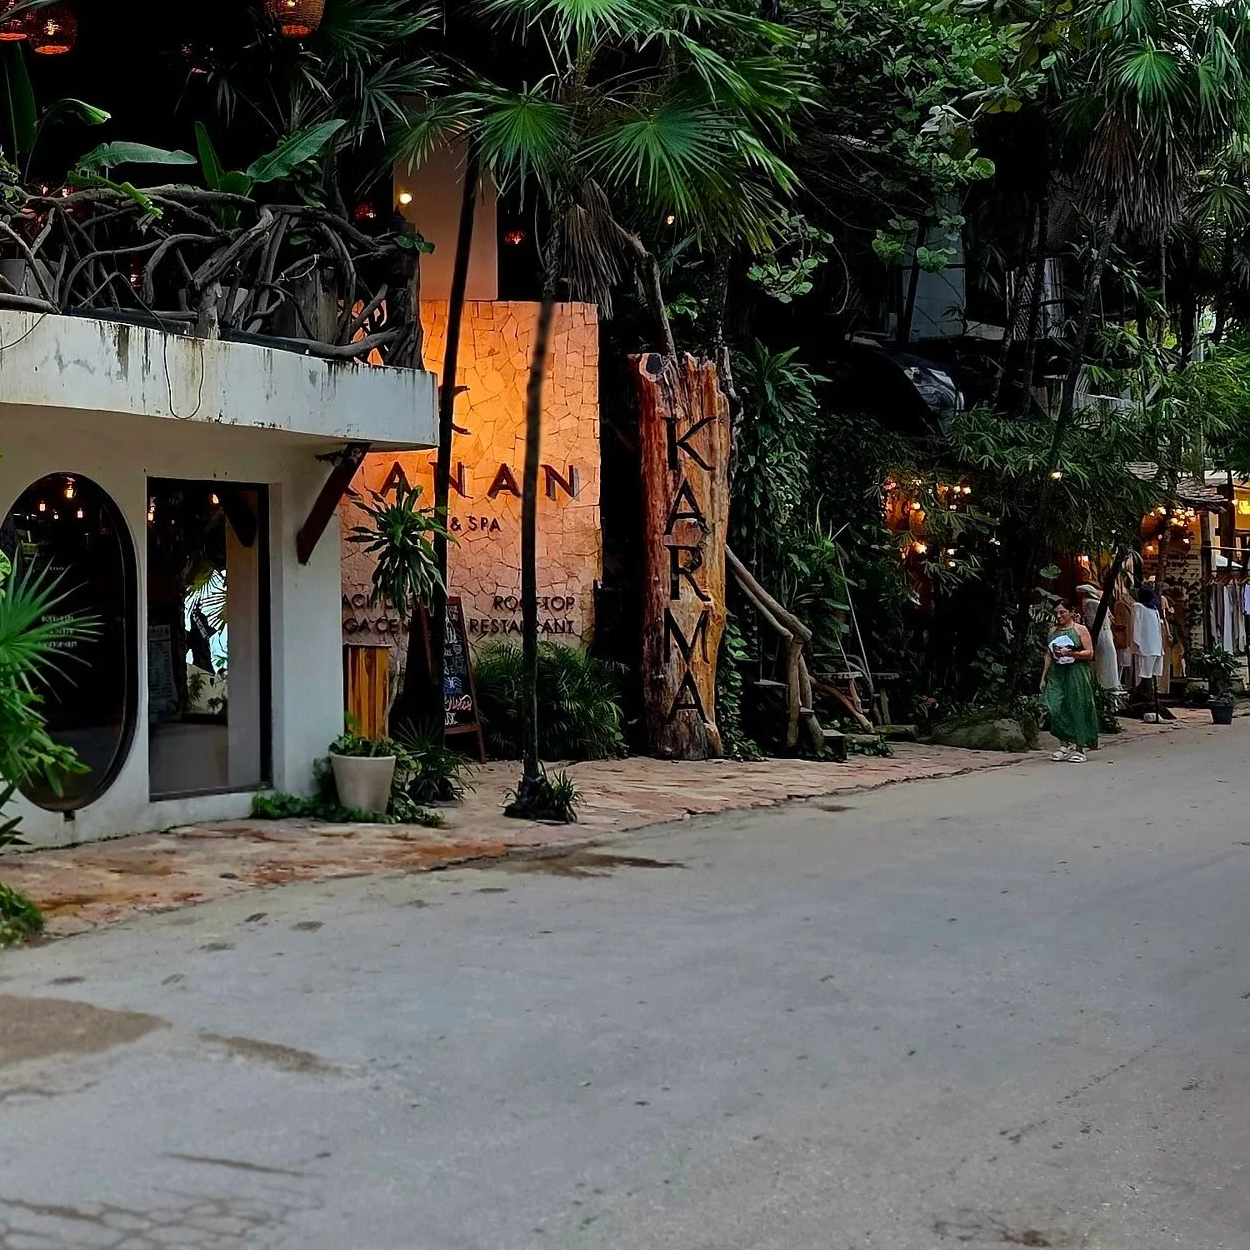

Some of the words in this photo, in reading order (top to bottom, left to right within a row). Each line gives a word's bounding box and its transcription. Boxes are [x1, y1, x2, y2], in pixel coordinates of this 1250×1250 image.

[380, 461, 578, 500] ANAN
[450, 517, 461, 531] &
[467, 516, 501, 531] SPA
[662, 416, 716, 724] KARMA
[493, 596, 575, 611] ROTOP
[469, 619, 575, 633] RESTAANT
